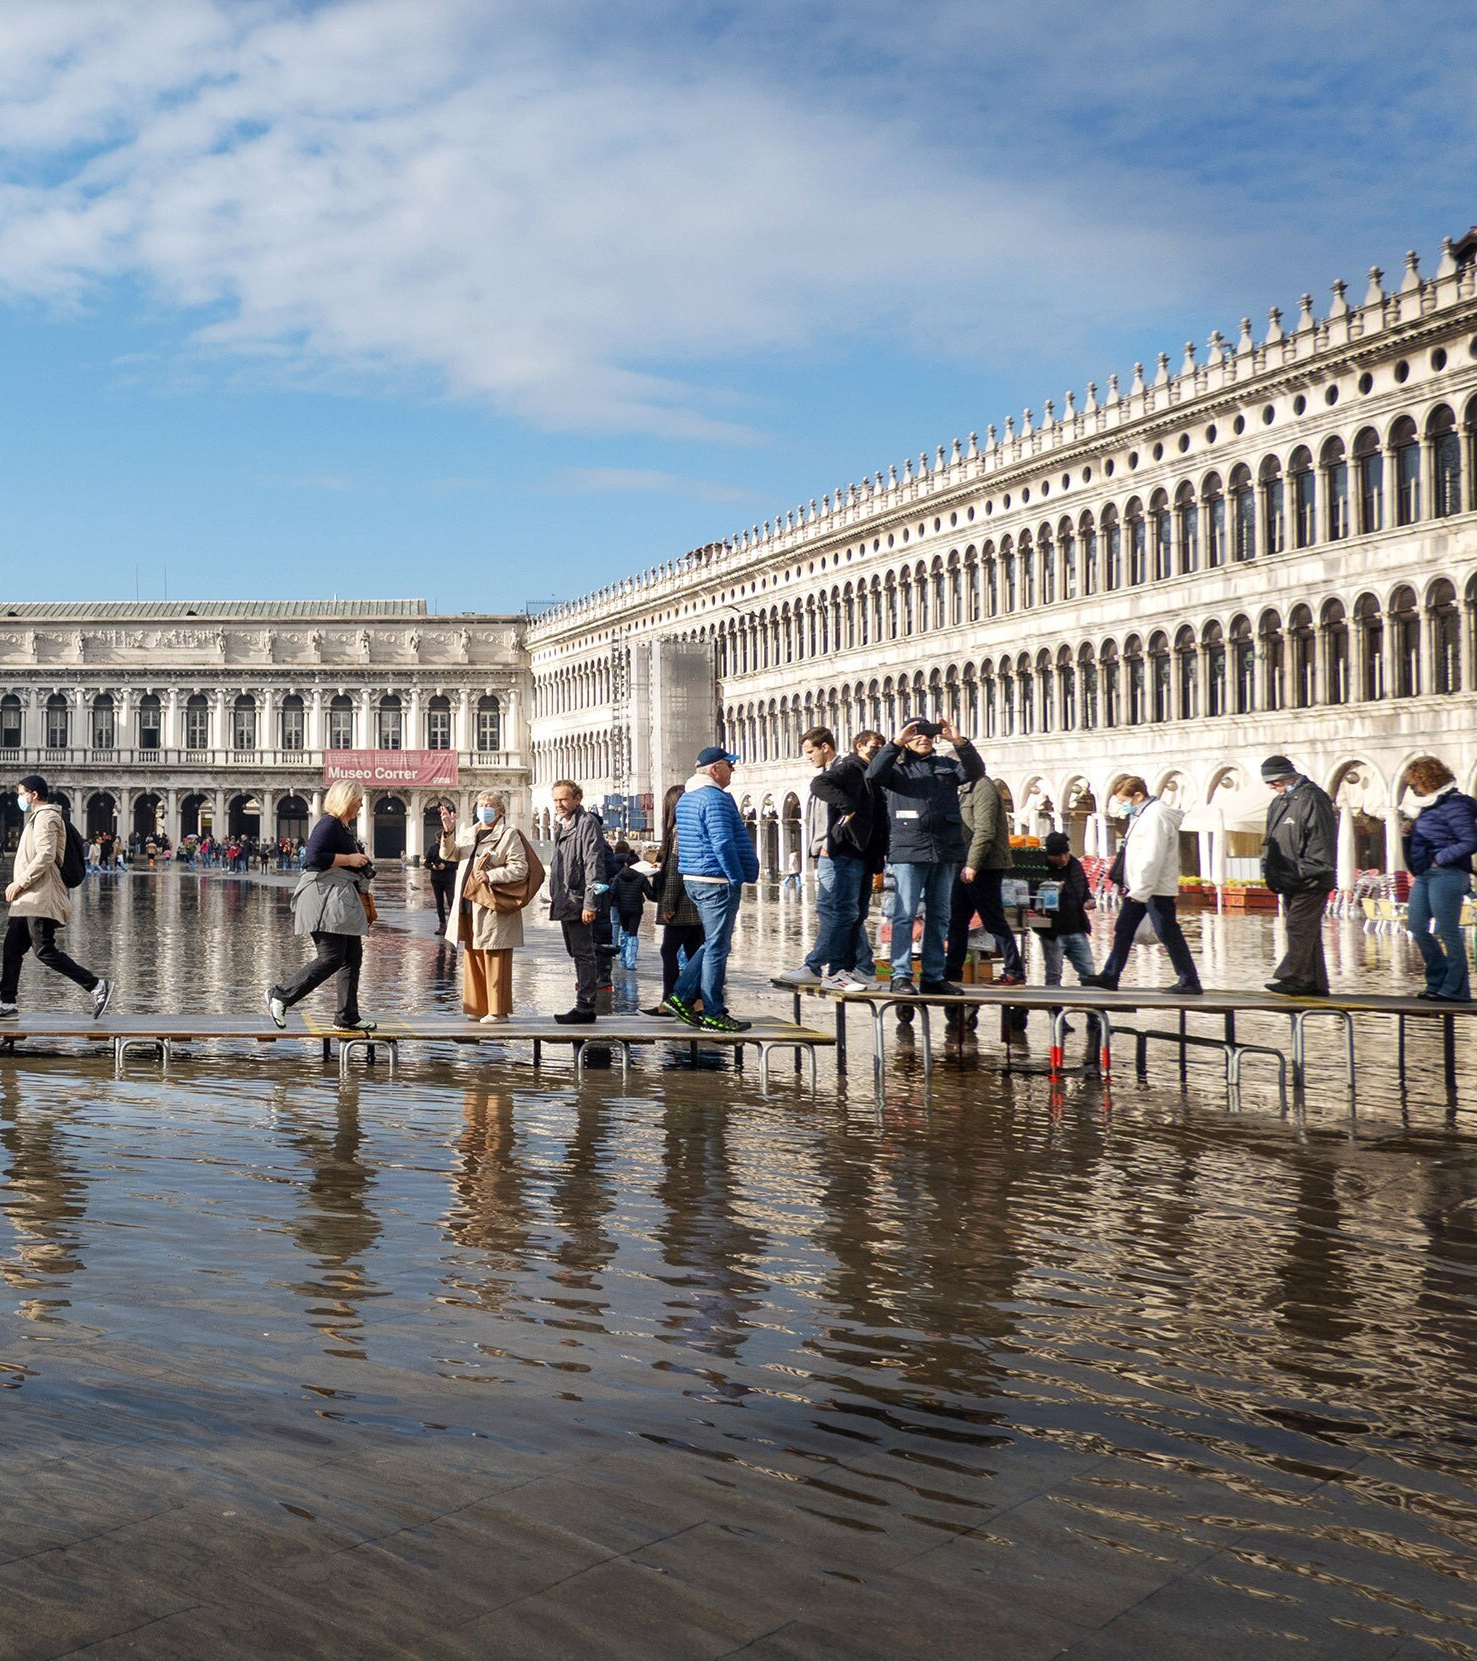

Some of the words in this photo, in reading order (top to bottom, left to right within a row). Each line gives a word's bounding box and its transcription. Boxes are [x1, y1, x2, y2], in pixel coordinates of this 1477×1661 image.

[328, 766, 372, 779] Museo
[375, 767, 418, 780] Correr
[98, 994, 105, 1002] N
